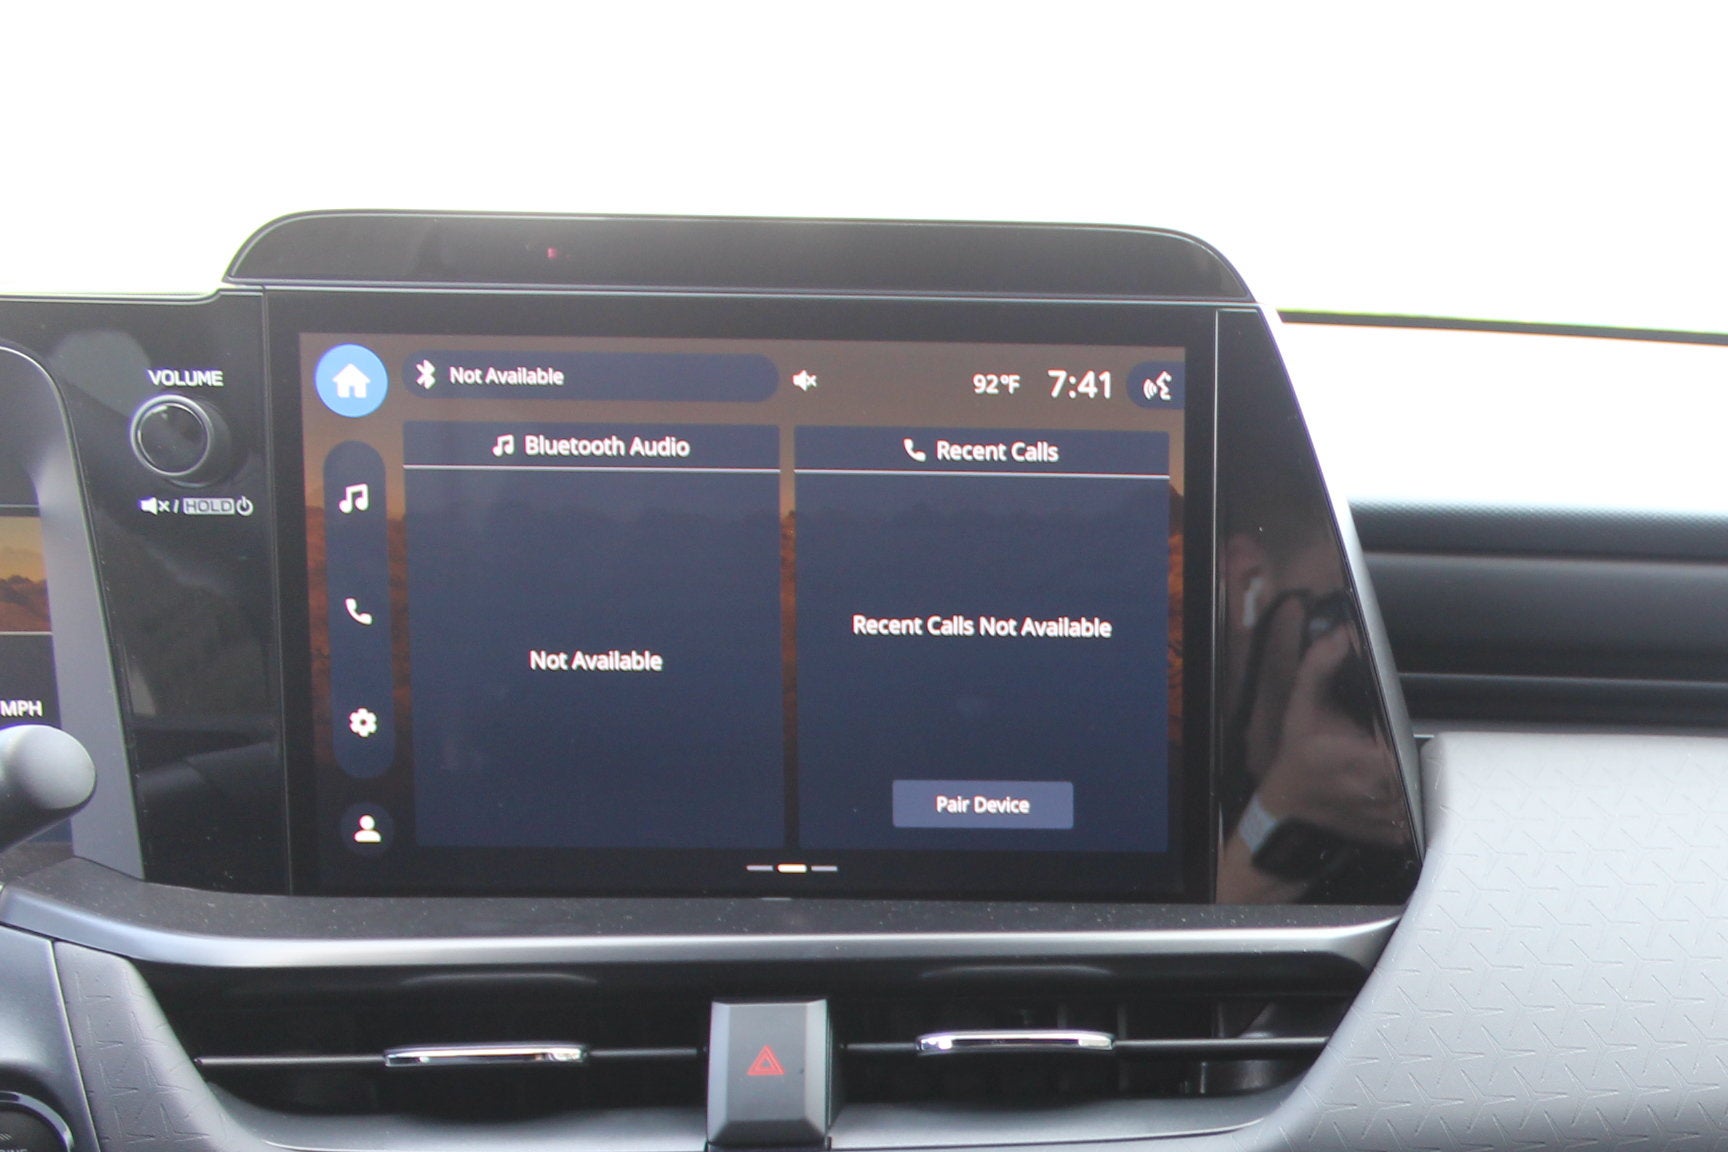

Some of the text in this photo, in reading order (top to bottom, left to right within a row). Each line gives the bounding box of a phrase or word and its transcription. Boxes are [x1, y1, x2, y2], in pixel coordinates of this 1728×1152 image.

[148, 369, 224, 387] VOLUME
[450, 366, 564, 386] Not Available
[973, 374, 1020, 394] 92°F
[1047, 370, 1111, 399] 7:41
[525, 435, 690, 457] Bluetooth Audio
[937, 440, 1059, 462] Recent Calls
[184, 499, 234, 514] HOLD
[853, 614, 1112, 638] Recent Calls Not Available
[529, 650, 663, 671] Not Available
[0, 699, 43, 717] MPH
[936, 795, 1030, 814] Pair Device
